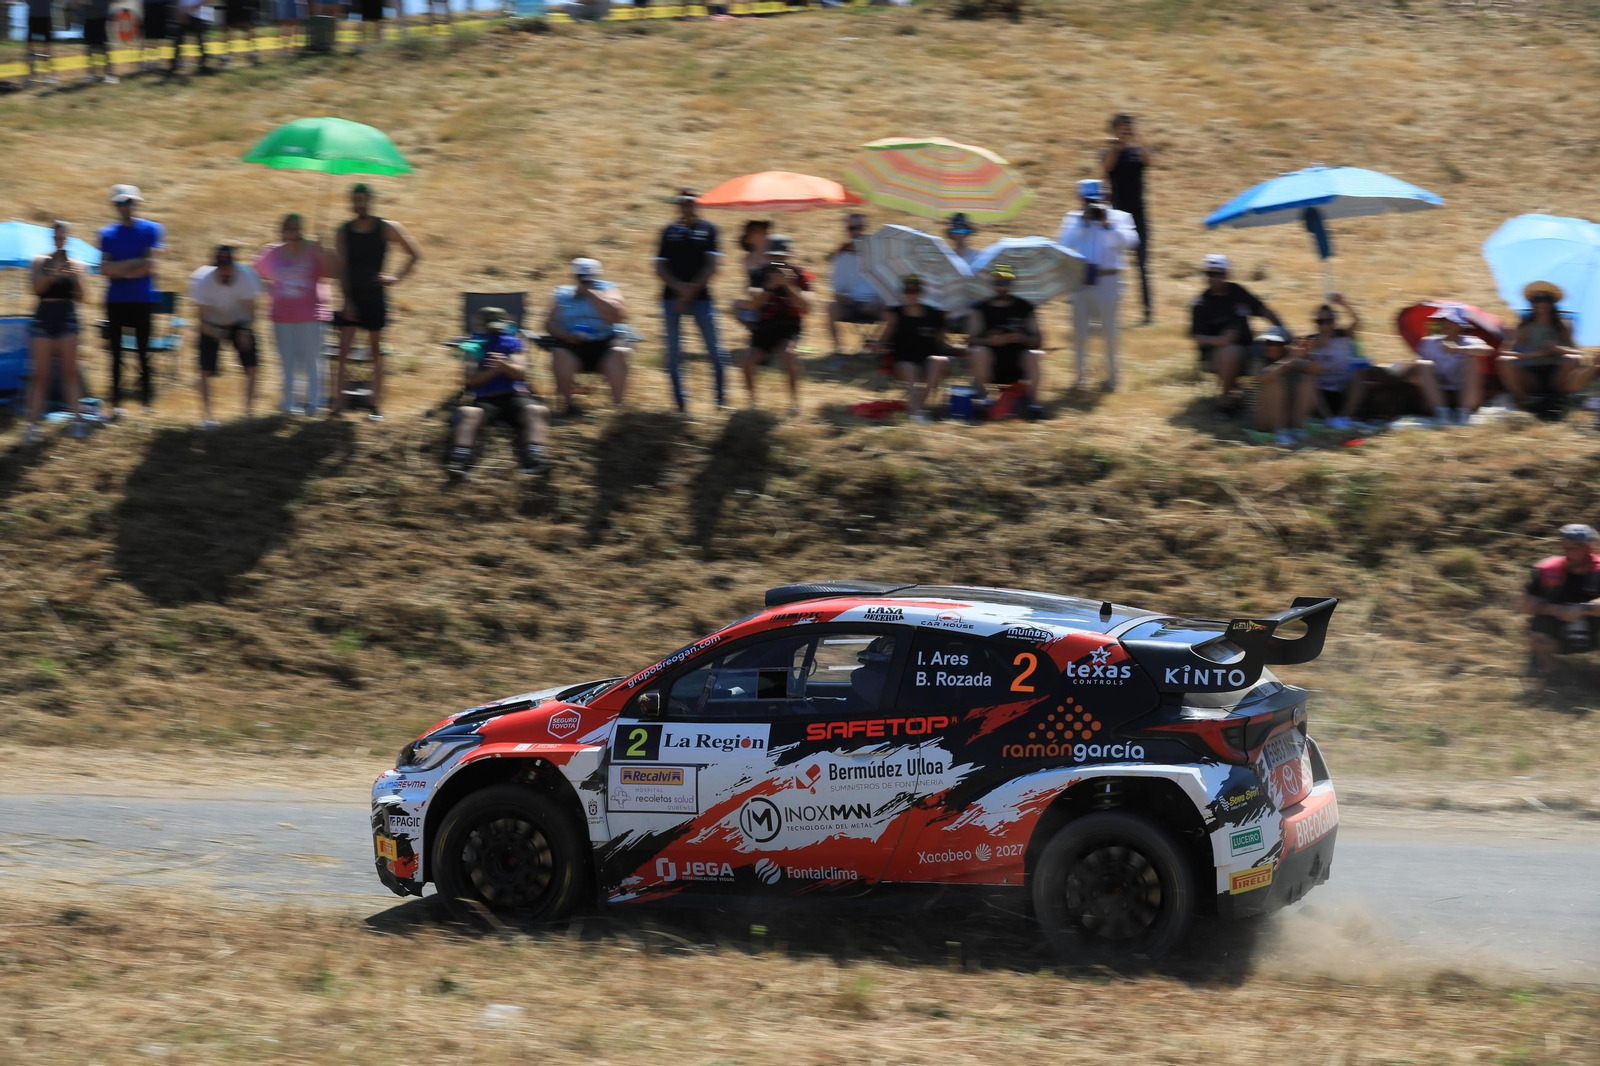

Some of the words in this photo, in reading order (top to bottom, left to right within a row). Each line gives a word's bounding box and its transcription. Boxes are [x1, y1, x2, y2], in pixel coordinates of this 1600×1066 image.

[863, 613, 905, 622] BECERRA
[867, 606, 903, 615] CASA
[921, 620, 940, 628] CAR
[627, 635, 721, 688] grupobreogan.com
[917, 651, 926, 666] I.
[930, 651, 969, 666] Ares
[1010, 652, 1038, 693] 2
[1066, 661, 1131, 679] texas
[915, 672, 931, 687] B.
[935, 671, 993, 687] Rozada
[626, 728, 648, 757] 2
[663, 733, 690, 748] La
[632, 770, 671, 782] Recalvi
[829, 760, 903, 781] Bermúdez
[907, 758, 943, 776] Ulloa
[377, 780, 427, 790] CLIMAREYMA
[830, 782, 880, 792] SUMINISTROS
[882, 782, 893, 790] DE
[635, 794, 672, 803] recoletas
[674, 796, 694, 804] salud
[785, 803, 872, 822] INOXMAN
[786, 824, 833, 832] TECNOLOGIA
[1233, 832, 1259, 846] LUCEIRO
[917, 849, 972, 865] Xacobeo
[996, 844, 1024, 858] 2027
[786, 865, 858, 880] Fontalclima
[1232, 868, 1272, 890] PIRELLI
